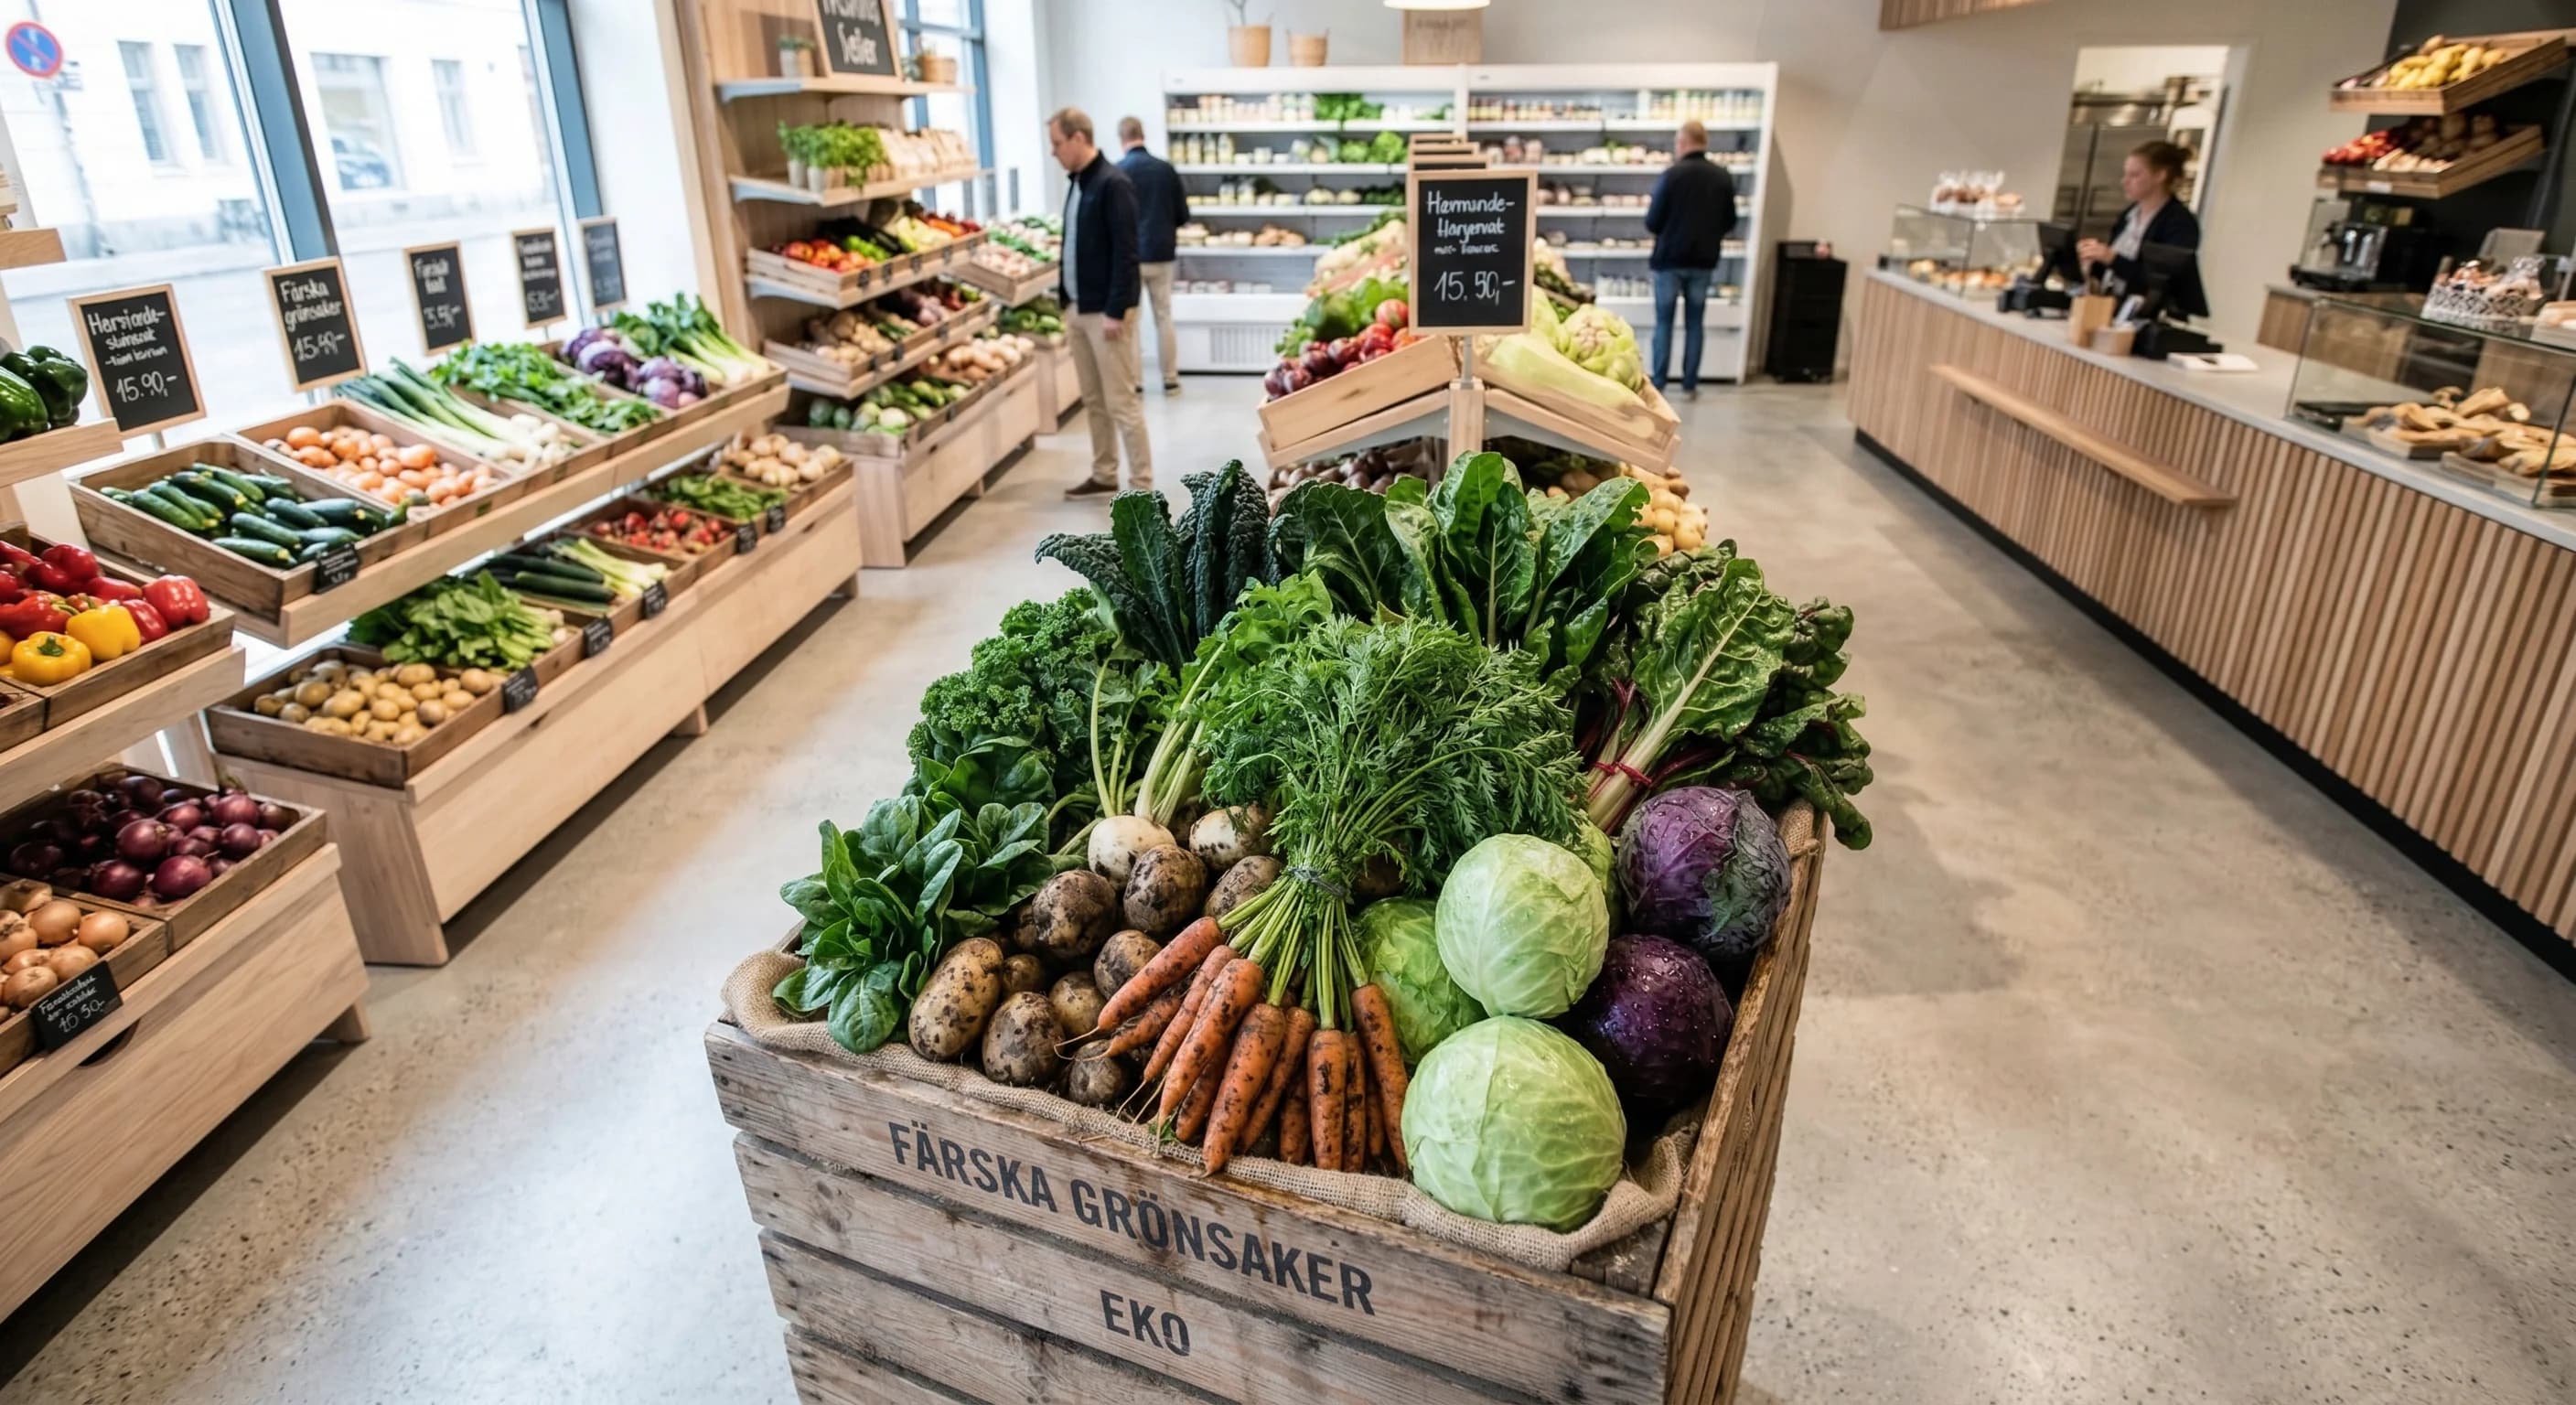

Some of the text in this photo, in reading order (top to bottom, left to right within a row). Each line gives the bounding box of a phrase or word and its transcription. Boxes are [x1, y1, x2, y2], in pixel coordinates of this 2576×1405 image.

[887, 1119, 1376, 1316] FÄRSKA GRÖNSAKER
[1100, 1288, 1191, 1357] EKO
